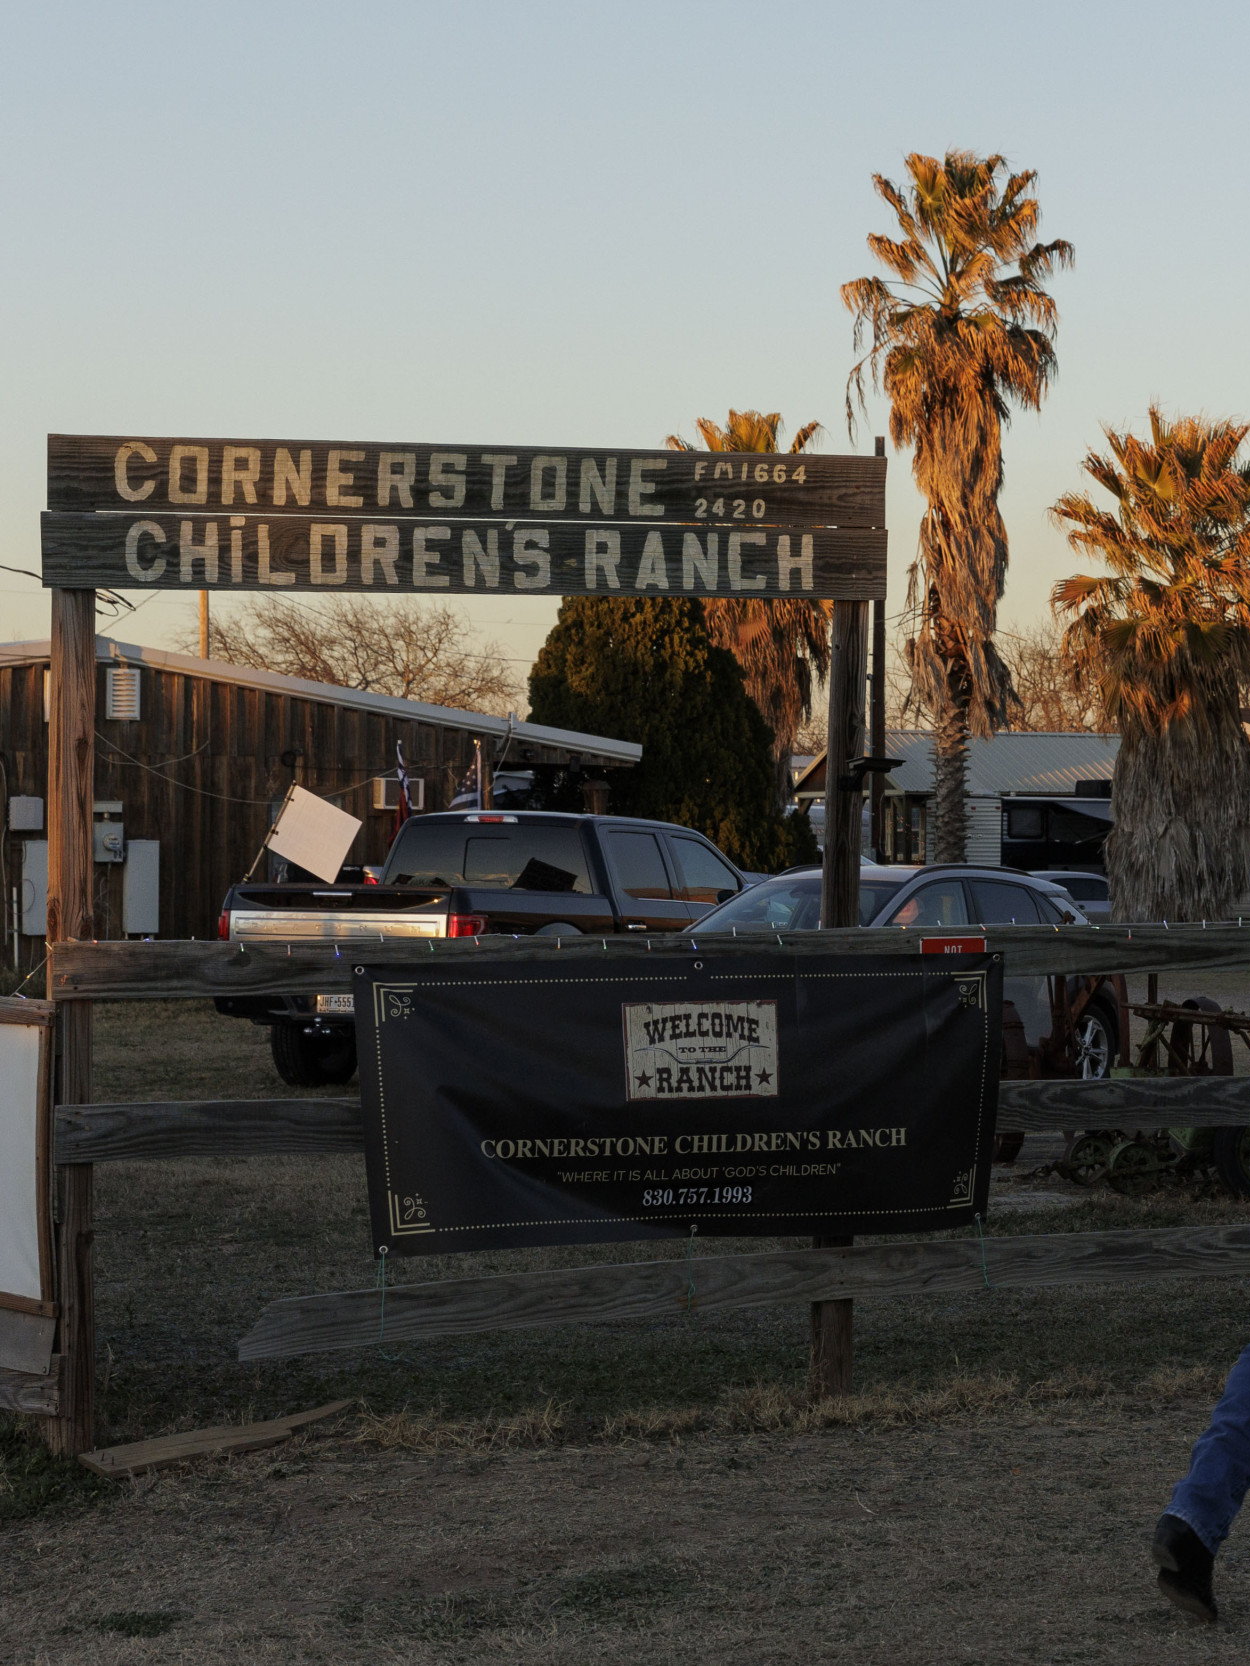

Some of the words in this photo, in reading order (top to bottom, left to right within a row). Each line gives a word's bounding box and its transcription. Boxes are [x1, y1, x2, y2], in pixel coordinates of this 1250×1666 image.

[114, 441, 668, 517] CORNERSTONE
[694, 498, 767, 519] 2420
[584, 529, 815, 591] RANCH
[944, 945, 963, 953] NOT
[643, 1012, 761, 1046] WELCOME
[656, 1065, 752, 1094] RANCH
[480, 1136, 668, 1159] CORNERSTONE
[674, 1131, 821, 1154] CHILDREN'S
[826, 1128, 907, 1149] RANCH
[557, 1170, 611, 1183] "WHERE
[613, 1170, 626, 1182] IT
[629, 1170, 641, 1181] IS
[644, 1169, 669, 1181] ALL
[672, 1168, 719, 1180] ABOUT
[769, 1163, 841, 1177] CHILDREN"
[642, 1186, 753, 1207] 830.757.1993
